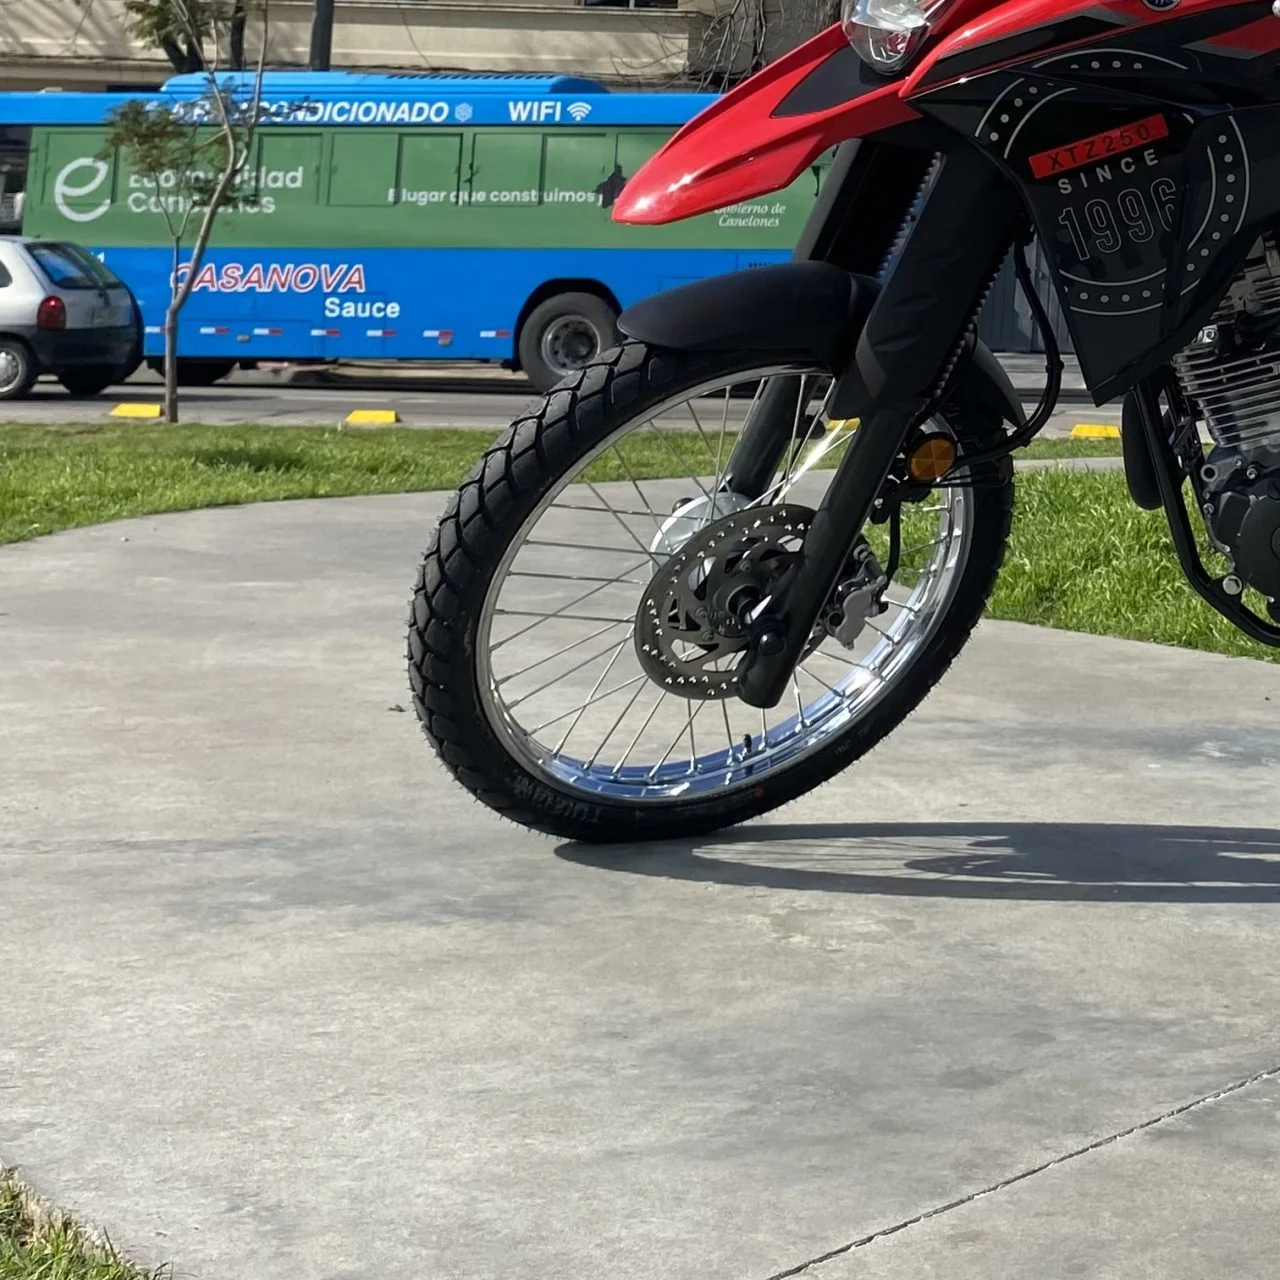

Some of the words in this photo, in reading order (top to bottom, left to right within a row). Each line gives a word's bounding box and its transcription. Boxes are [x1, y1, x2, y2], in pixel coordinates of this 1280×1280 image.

[508, 101, 562, 121] WIFI
[1050, 123, 1151, 170] XTZ250
[1057, 148, 1159, 195] SINCE
[402, 188, 447, 206] lugar
[771, 203, 786, 214] de
[718, 214, 780, 227] Canelones
[170, 263, 366, 293] CASANOVA
[324, 297, 400, 318] Sauce
